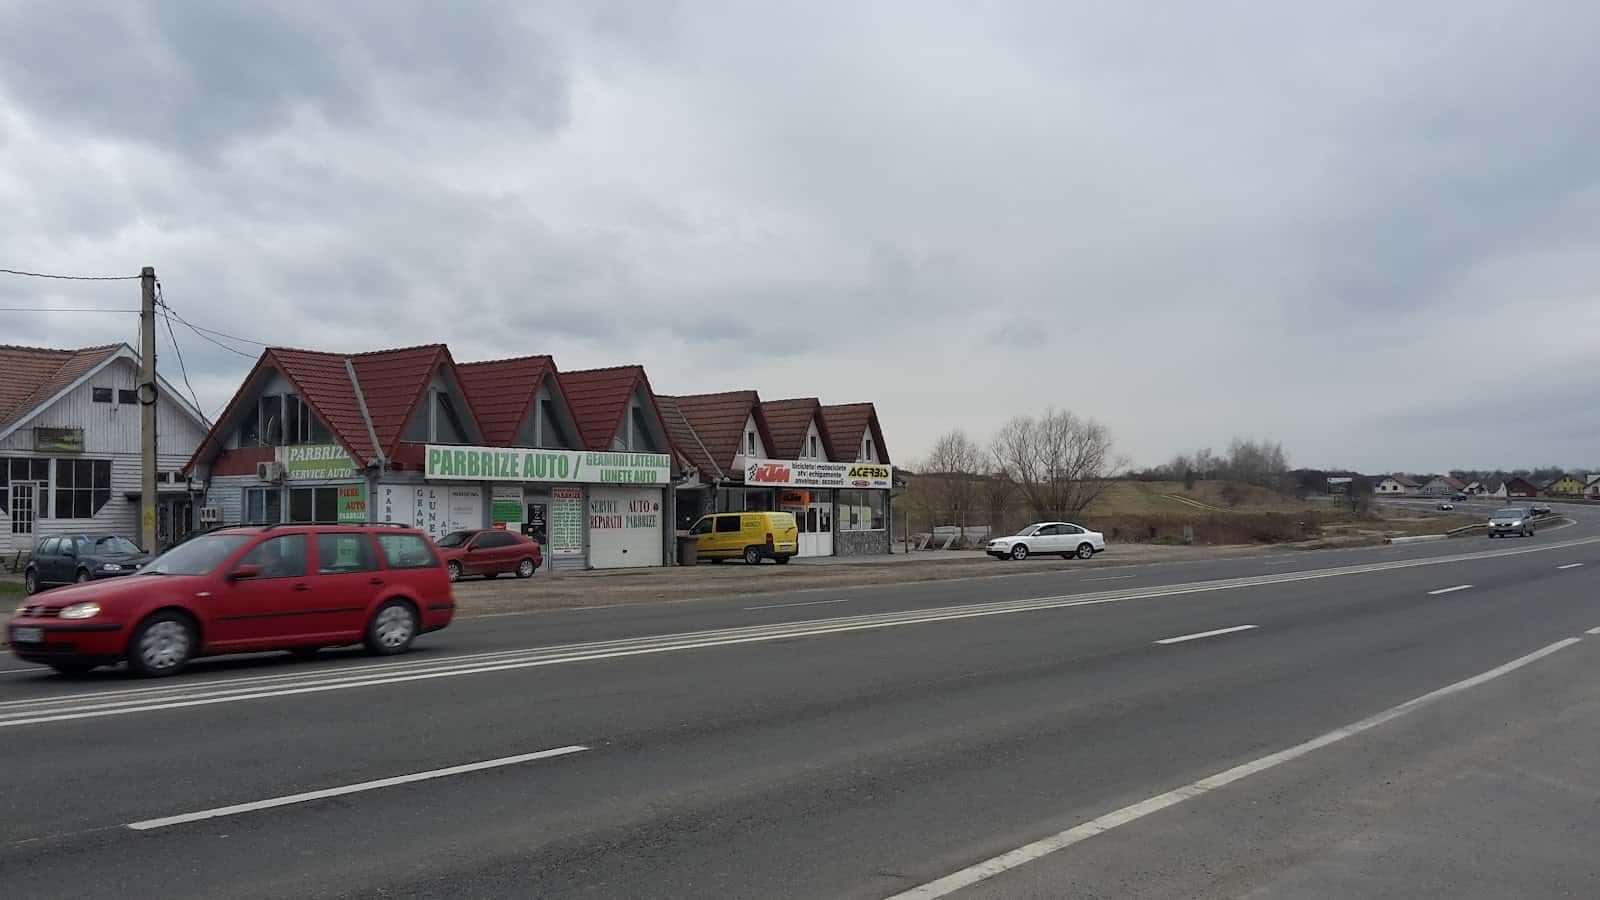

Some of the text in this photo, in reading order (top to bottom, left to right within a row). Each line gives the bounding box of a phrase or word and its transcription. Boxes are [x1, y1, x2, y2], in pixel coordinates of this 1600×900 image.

[428, 449, 519, 477] PARBRIZE
[523, 453, 569, 480] AUTO
[586, 453, 670, 468] GEAMURI LATERALE
[290, 467, 352, 479] SERVICE AUTO
[600, 469, 657, 483] LUNETE AUTO
[755, 463, 790, 483] KTM
[848, 467, 889, 478] ACERBIS
[345, 501, 366, 511] AUTO
[416, 489, 424, 527] GEAM
[591, 499, 650, 513] SERVICE AUTO
[590, 514, 657, 528] REPARATII PARBRIZE
